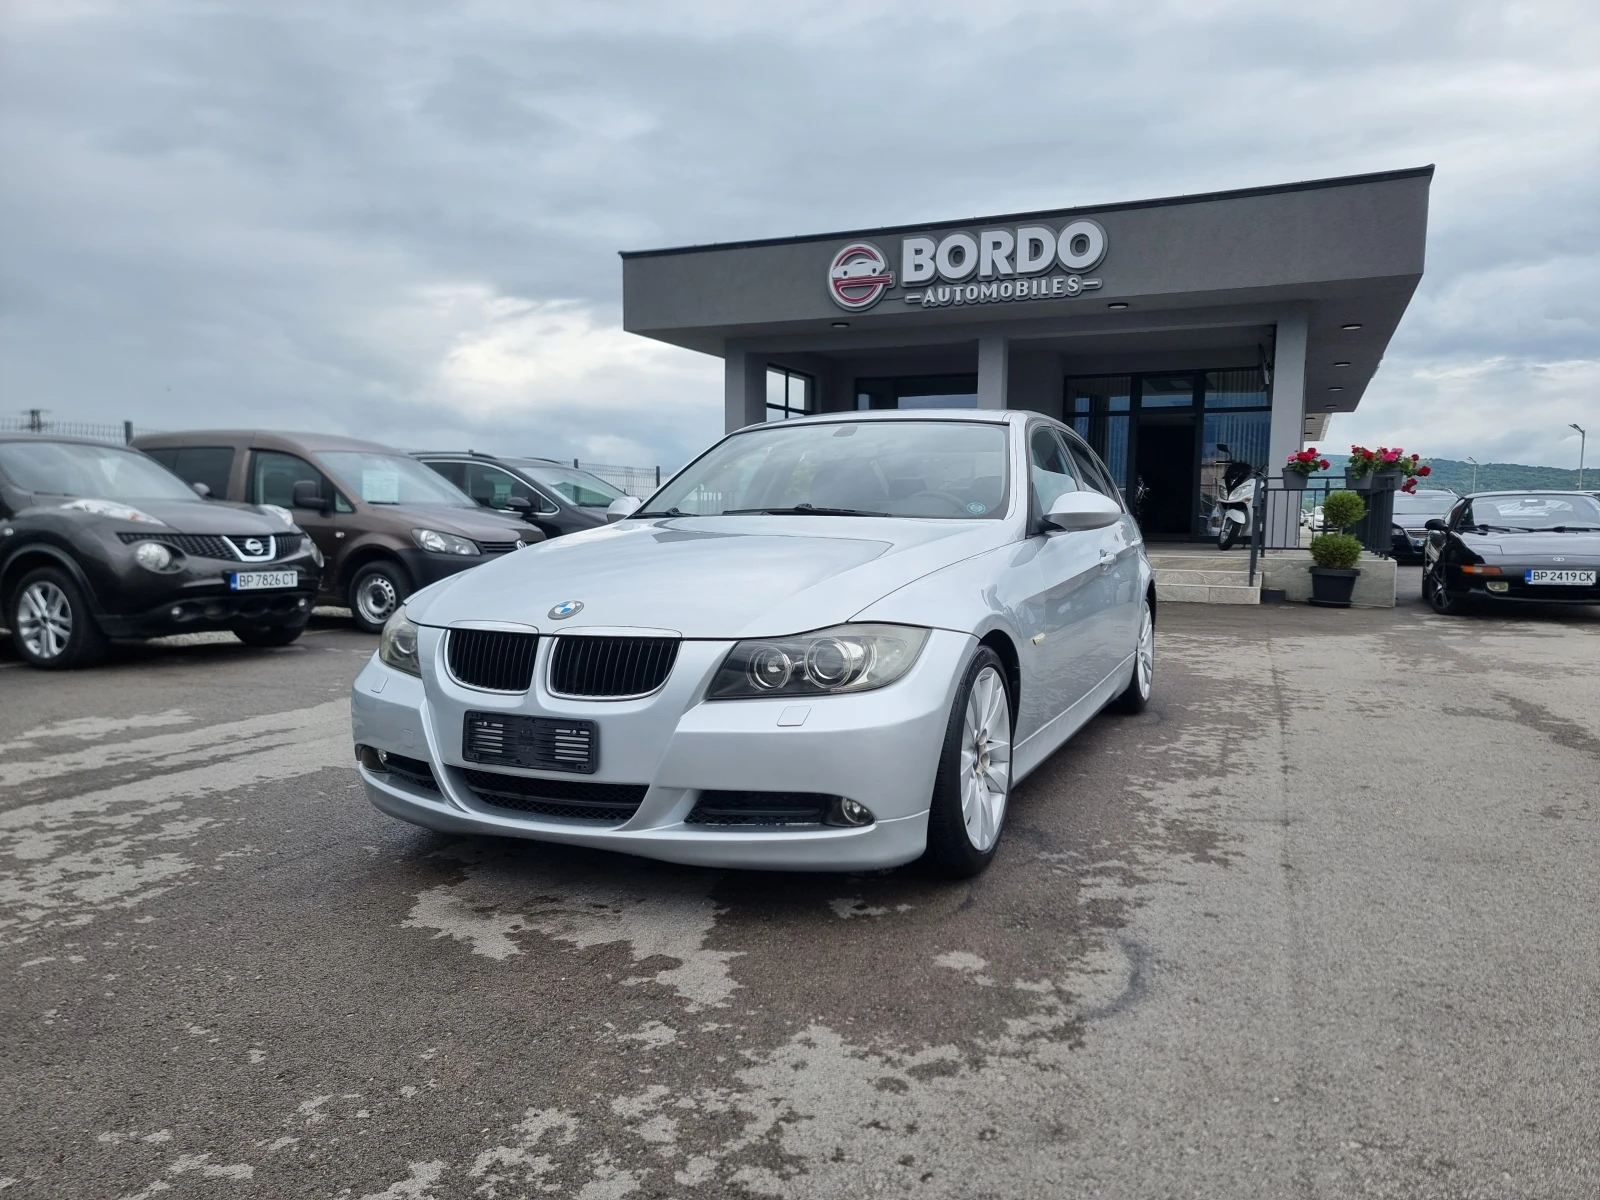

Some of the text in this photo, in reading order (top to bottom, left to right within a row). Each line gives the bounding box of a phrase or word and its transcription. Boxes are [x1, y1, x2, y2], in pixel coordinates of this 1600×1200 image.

[903, 221, 1104, 283] BORDO
[923, 277, 1079, 305] AUTOMOBILES
[256, 573, 281, 587] 7826
[1550, 571, 1577, 582] 2419
